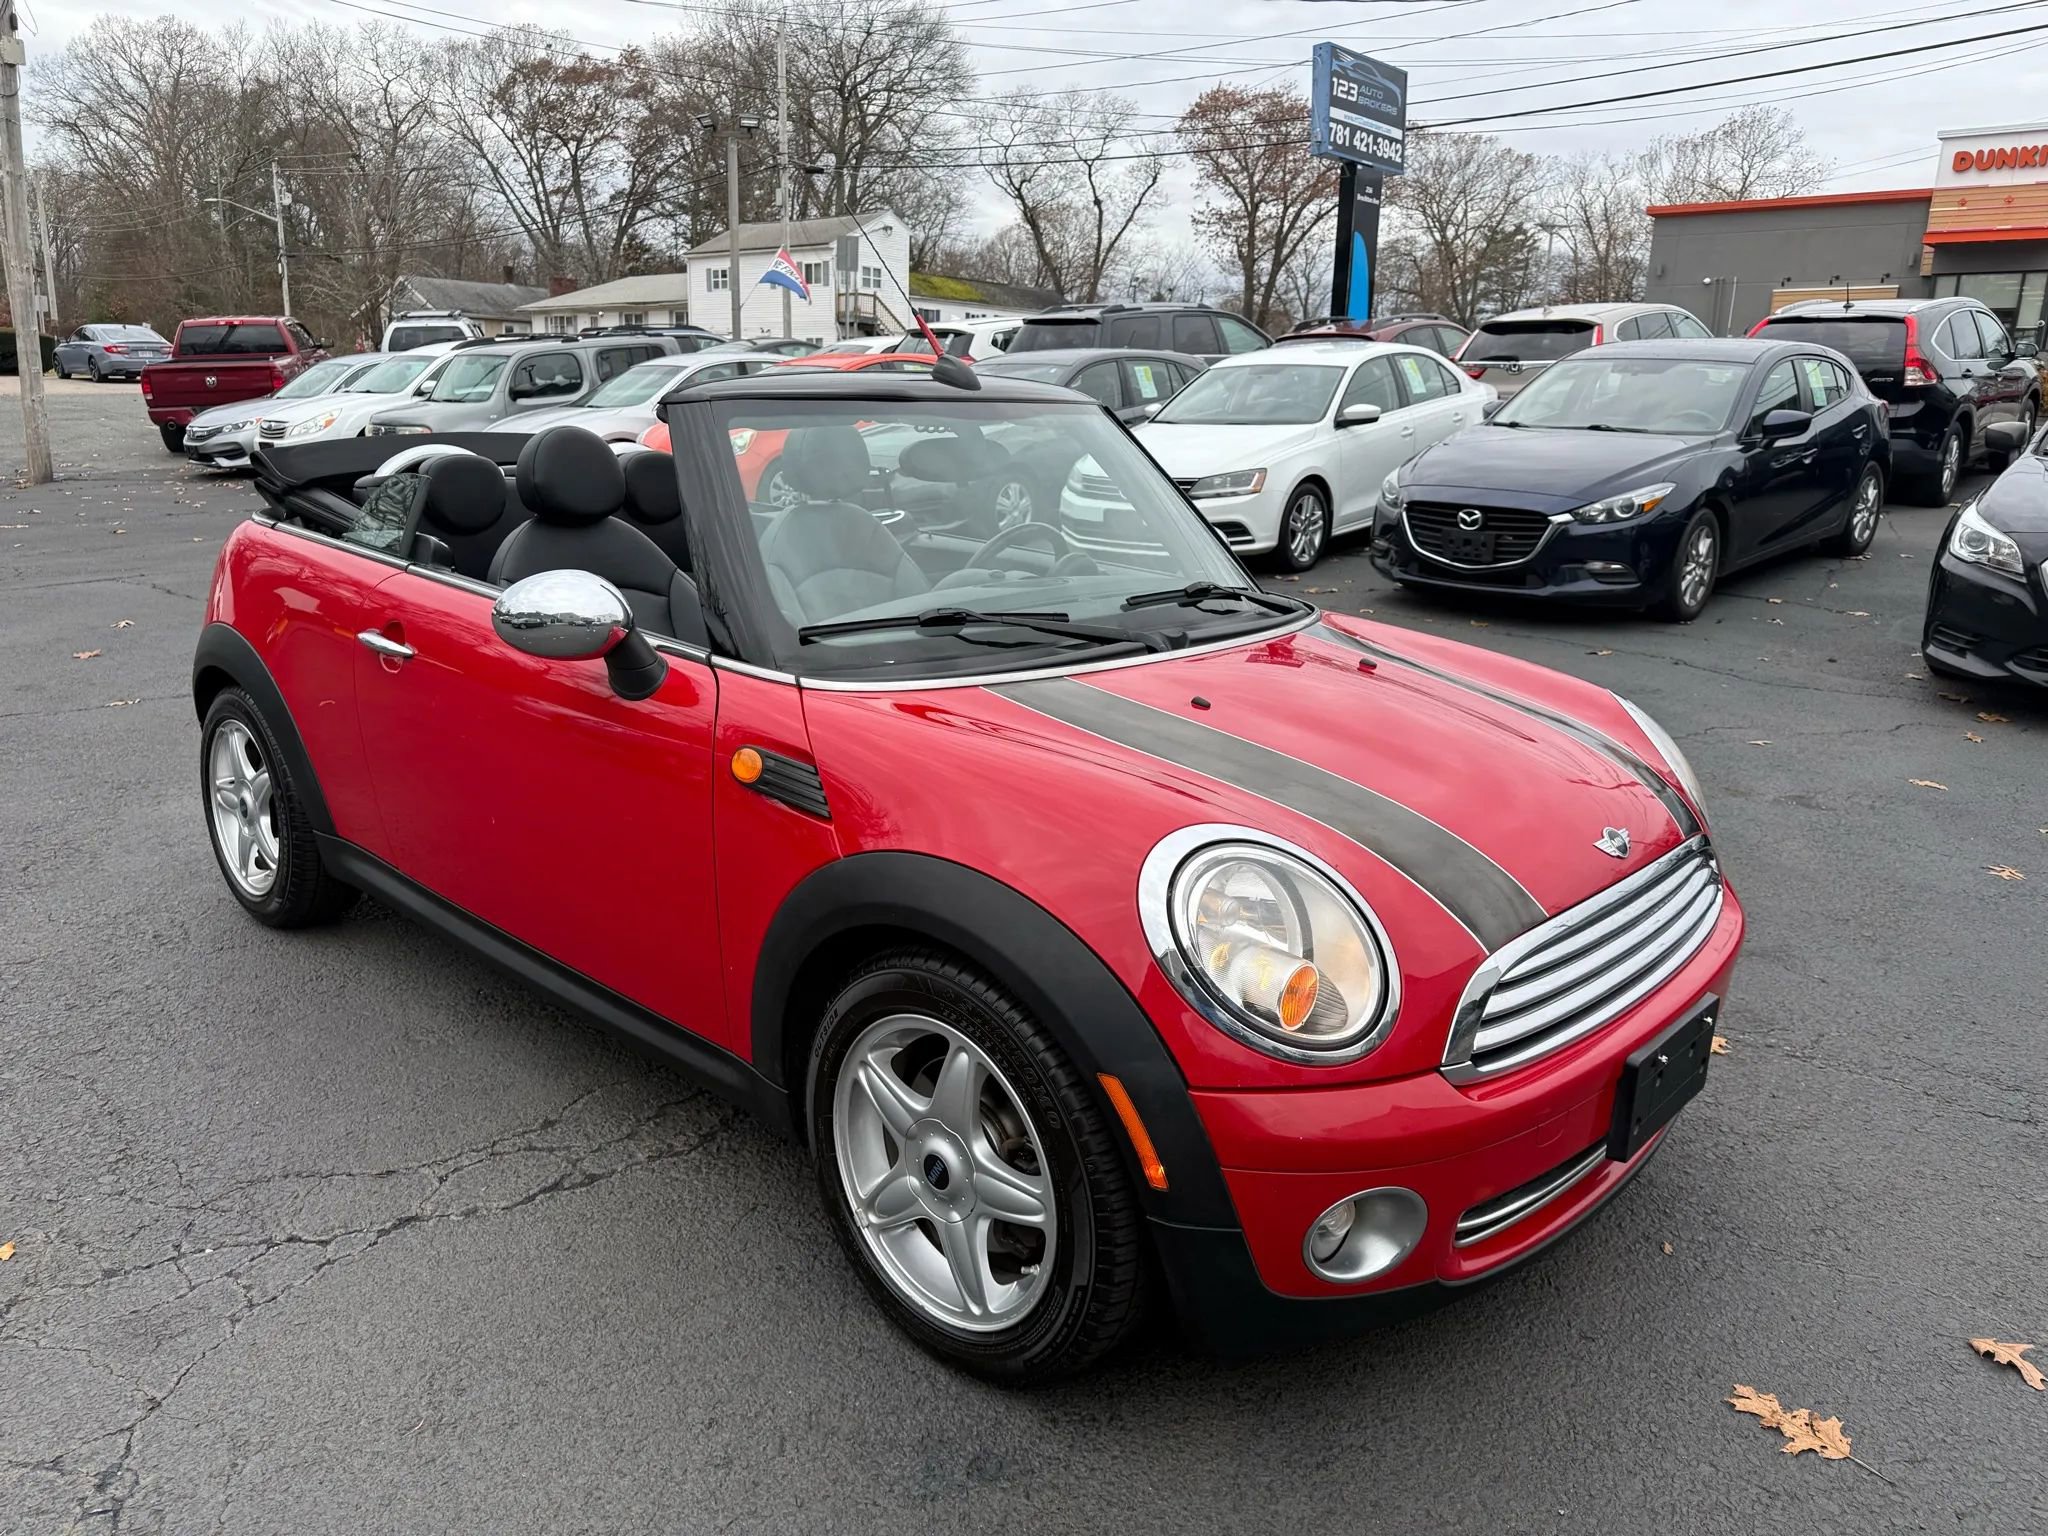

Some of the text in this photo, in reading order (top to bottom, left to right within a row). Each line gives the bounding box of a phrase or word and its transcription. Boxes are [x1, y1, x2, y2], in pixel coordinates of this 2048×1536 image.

[1332, 77, 1358, 102] 123
[1359, 85, 1383, 99] AUTO
[1358, 96, 1398, 115] BROKERS
[1329, 121, 1350, 147] 781
[1353, 130, 1402, 163] 421-3942
[814, 1007, 839, 1058] OUTSIDE
[928, 1160, 945, 1184] MINI
